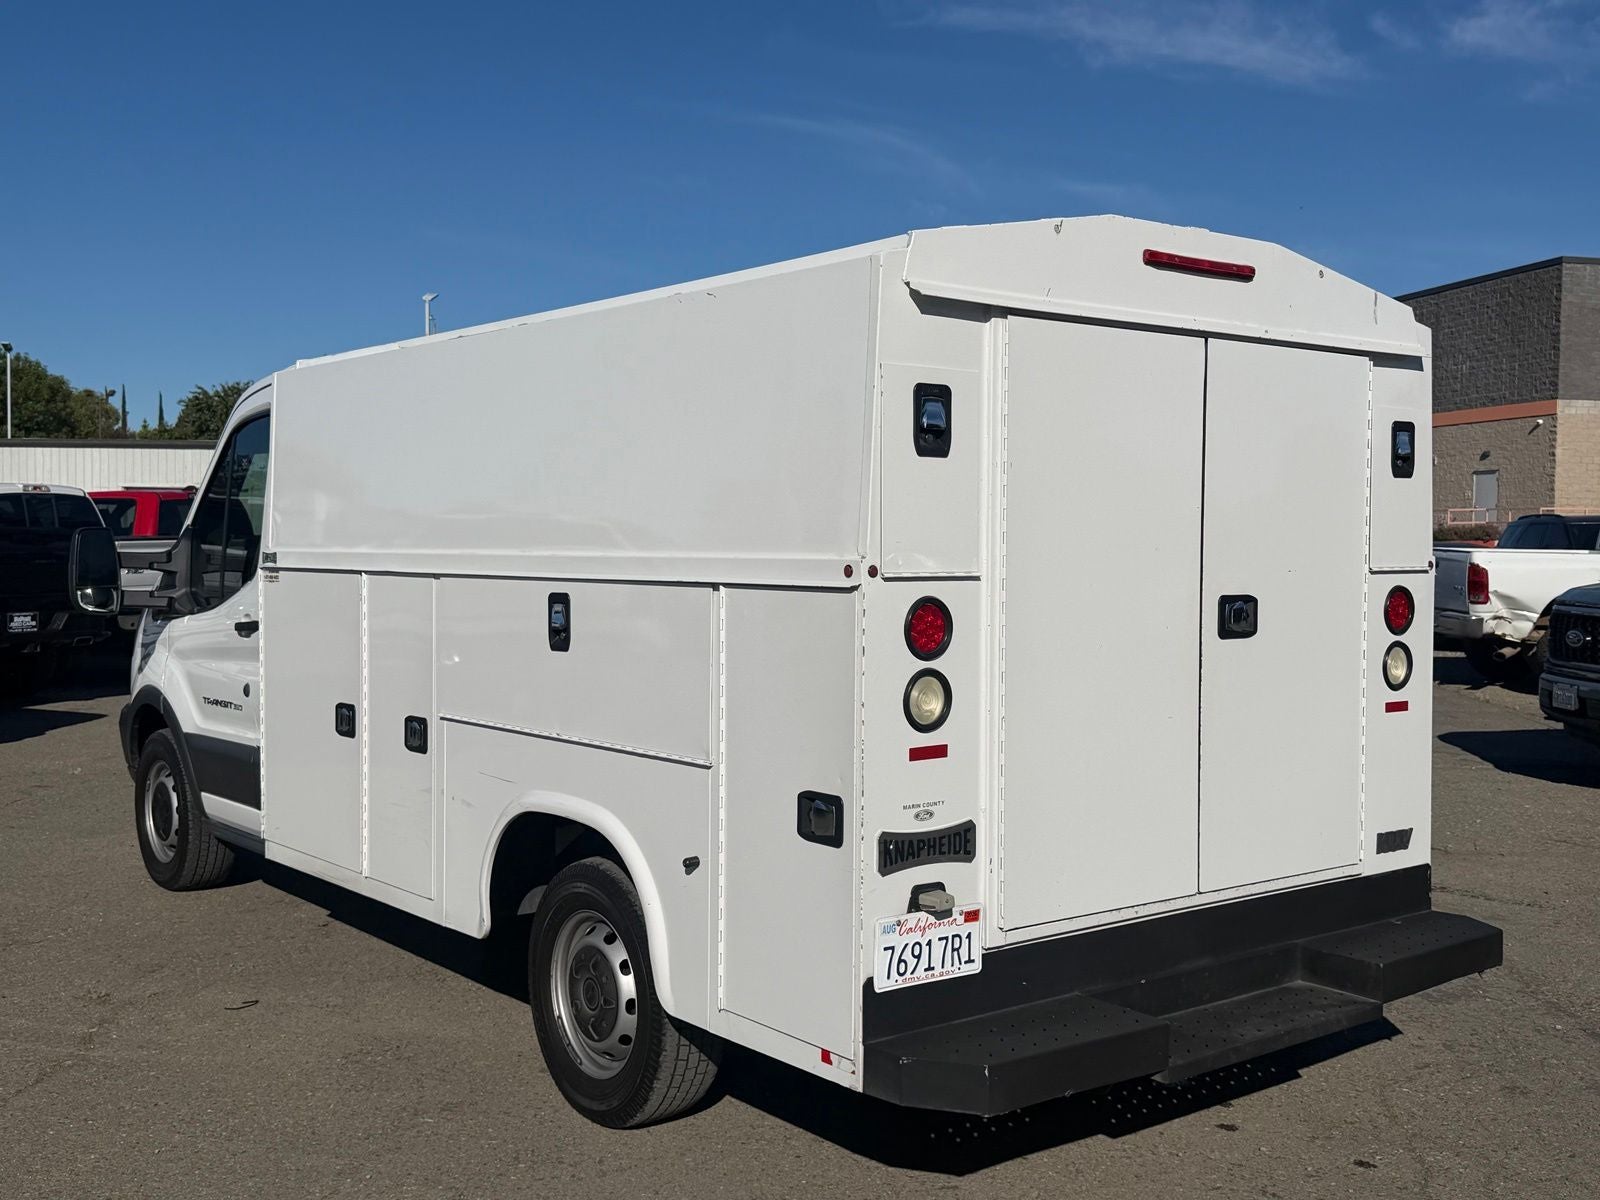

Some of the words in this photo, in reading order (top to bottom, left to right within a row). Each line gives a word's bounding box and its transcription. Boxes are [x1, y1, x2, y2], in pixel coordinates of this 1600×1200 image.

[202, 696, 234, 709] TRANSIT
[902, 803, 921, 811] MARIN
[922, 800, 945, 809] COUNTY
[883, 827, 972, 869] KNAPHEIDE
[882, 923, 897, 935] AUG
[898, 917, 964, 938] California
[883, 931, 976, 981] 76917R1
[901, 969, 956, 984] dmv.ca.gov
